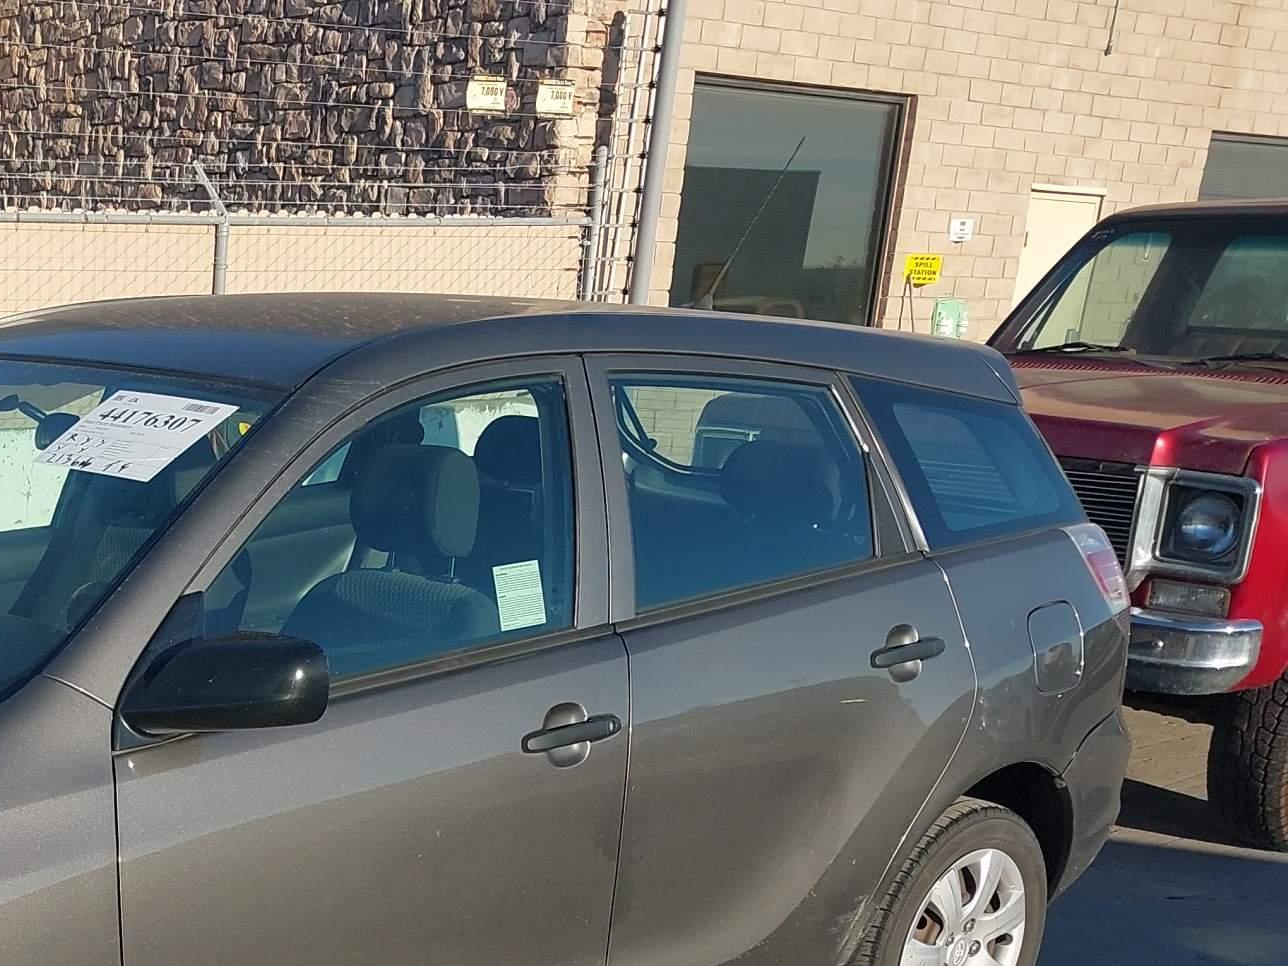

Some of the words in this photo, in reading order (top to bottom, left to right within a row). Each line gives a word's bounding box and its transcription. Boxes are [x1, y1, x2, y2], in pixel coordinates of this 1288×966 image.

[481, 86, 498, 97] 7,000
[499, 87, 504, 96] V
[551, 90, 567, 100] 7,000
[99, 407, 202, 432] 44176307
